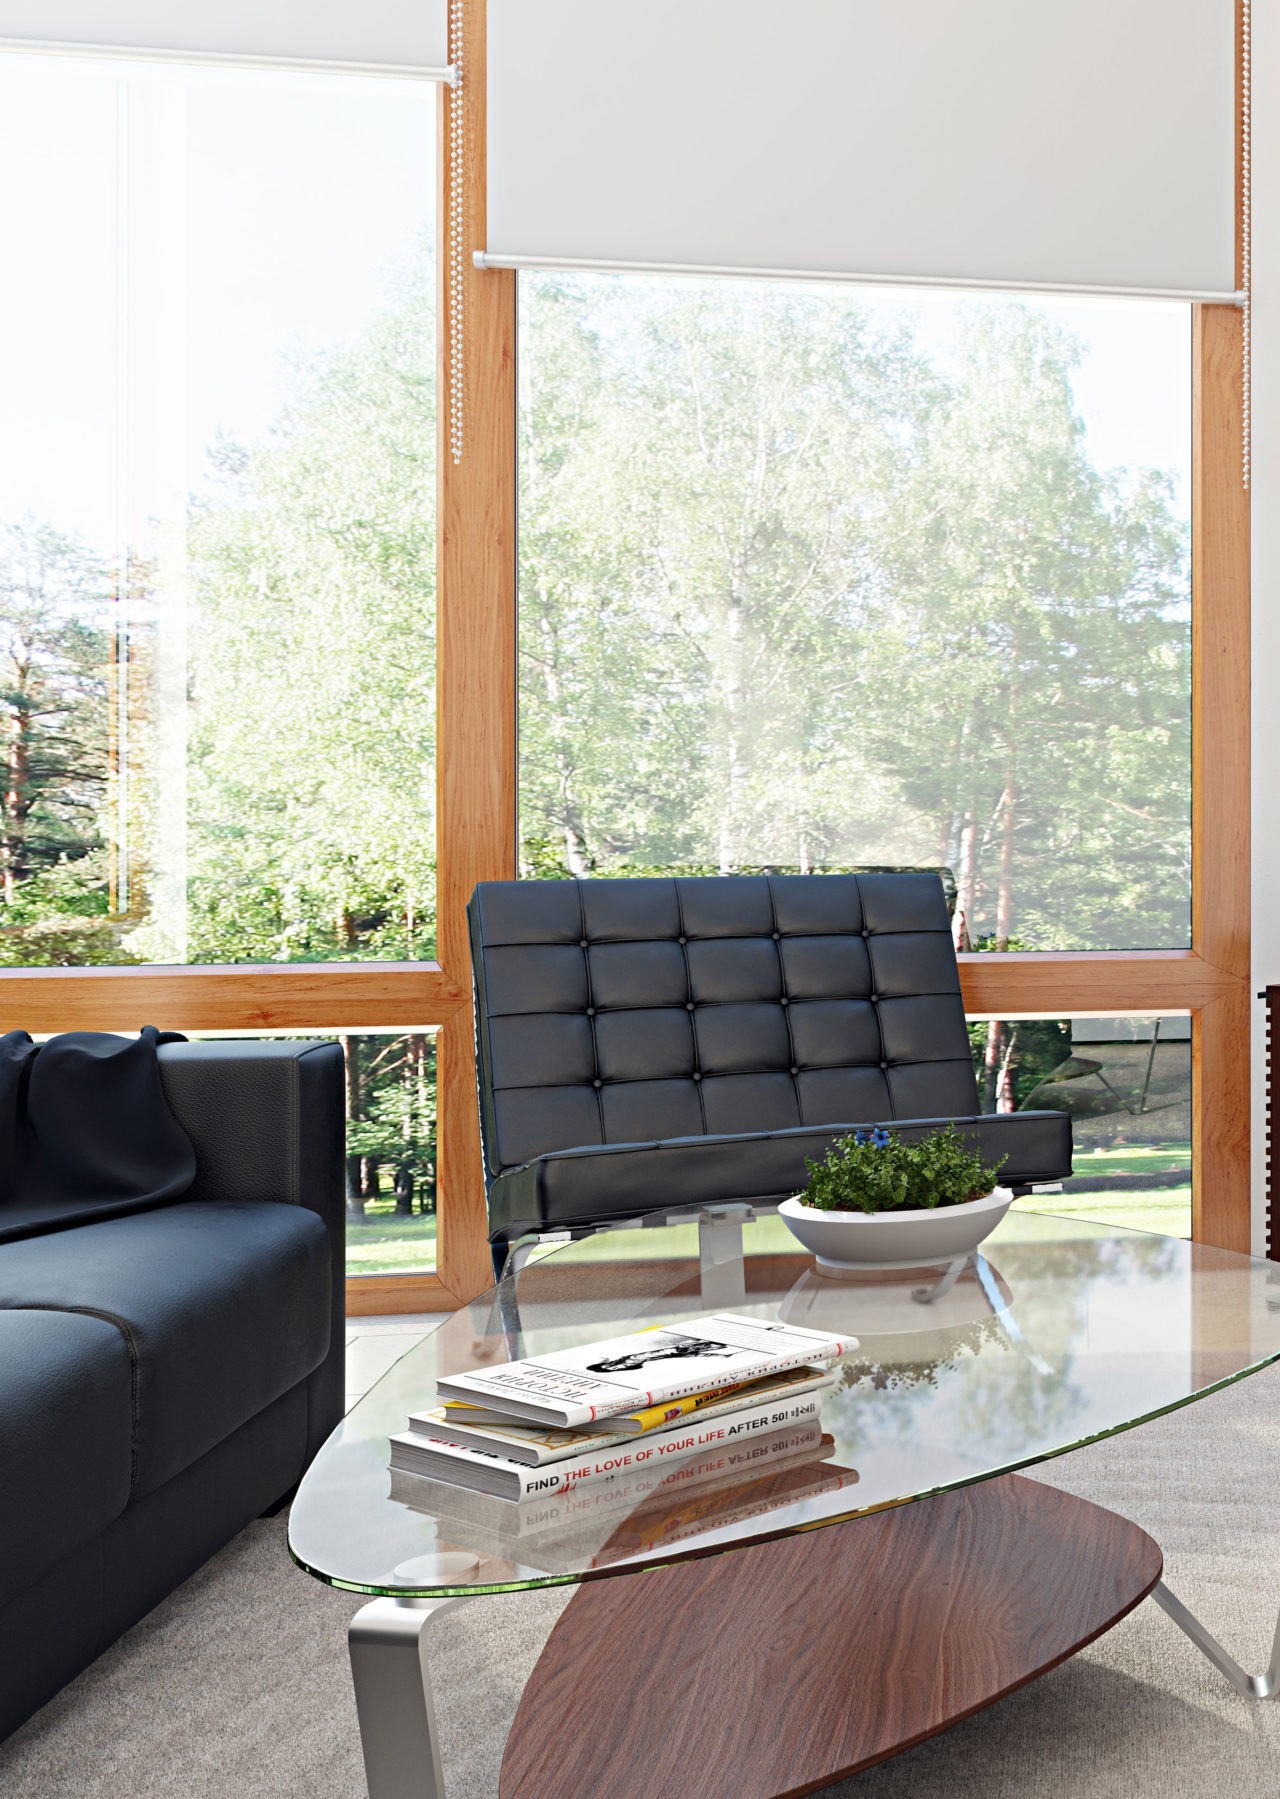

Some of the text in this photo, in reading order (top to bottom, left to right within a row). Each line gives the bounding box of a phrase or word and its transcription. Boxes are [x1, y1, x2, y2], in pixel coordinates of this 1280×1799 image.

[526, 1476, 560, 1494] FIND
[563, 1467, 592, 1482] THE
[595, 1458, 632, 1474] LOVE
[635, 1449, 654, 1462] OF
[657, 1437, 695, 1456] YOUR
[698, 1429, 725, 1445] LIFE
[728, 1416, 769, 1437] AFTER
[771, 1411, 789, 1425] 50!
